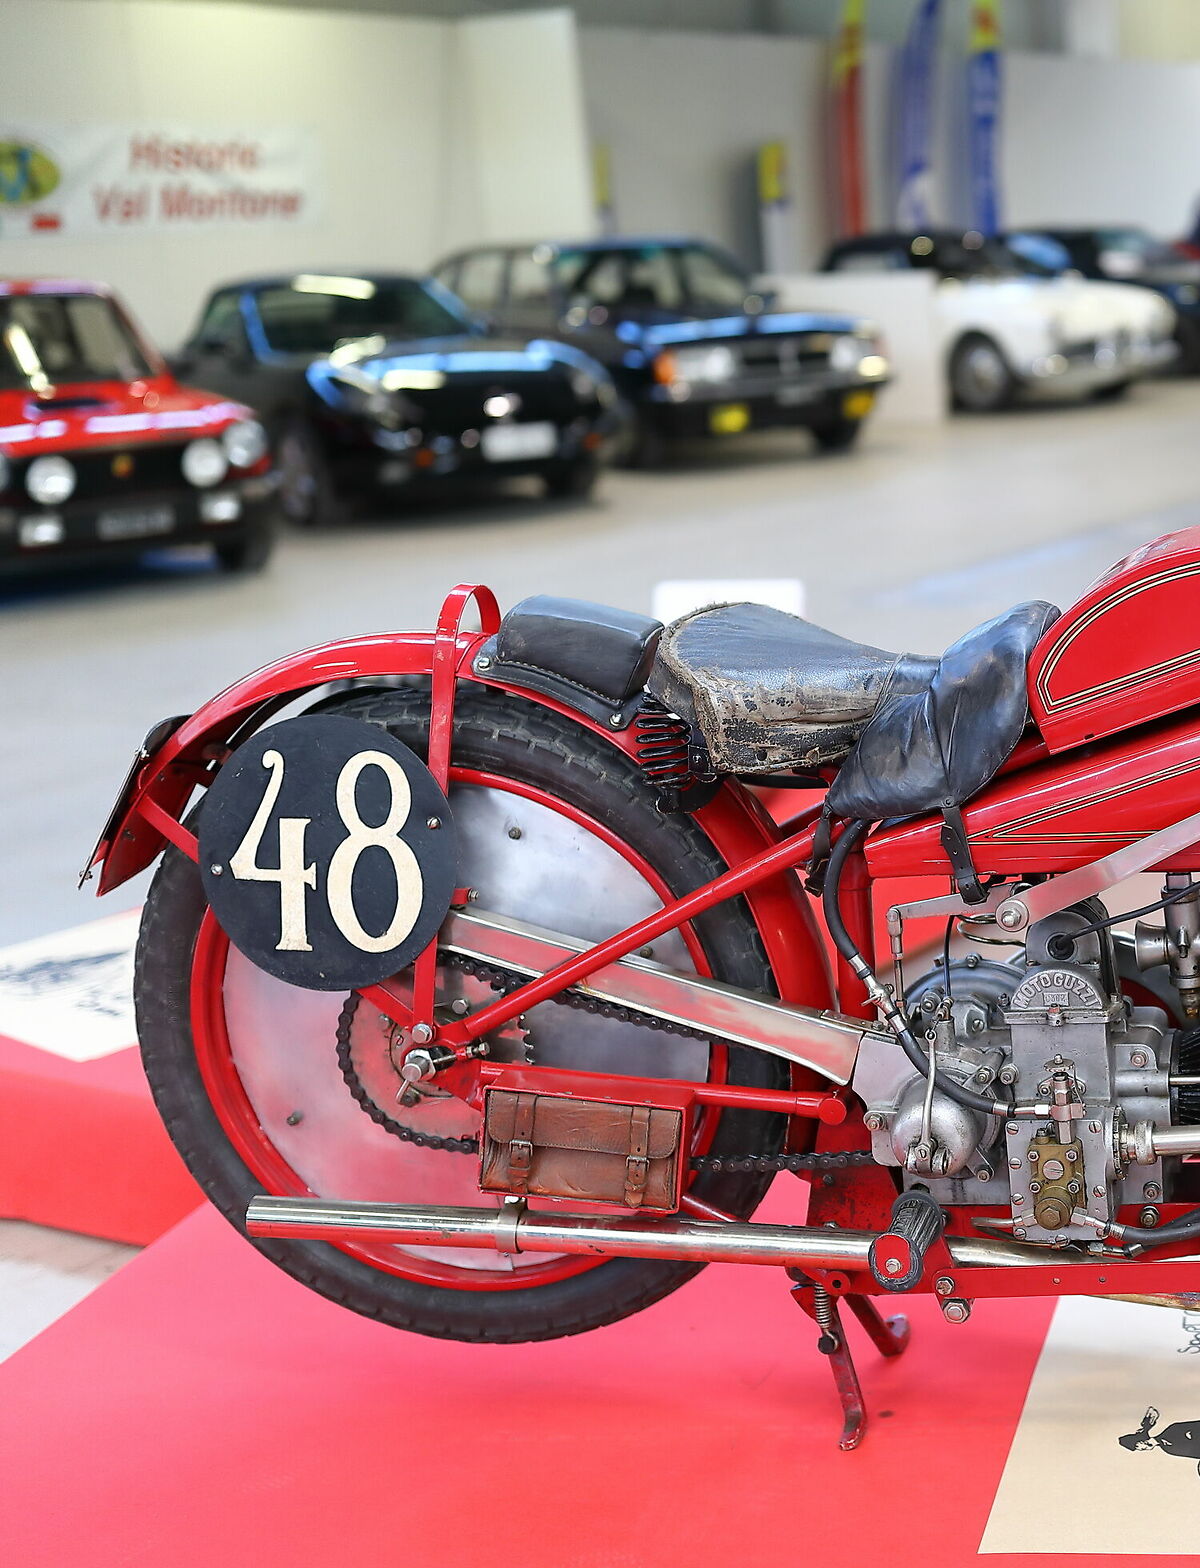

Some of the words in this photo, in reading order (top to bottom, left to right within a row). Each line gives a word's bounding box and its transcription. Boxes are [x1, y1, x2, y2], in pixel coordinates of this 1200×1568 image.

[228, 749, 424, 953] 48
[1013, 973, 1052, 1009] MOTO
[1053, 972, 1099, 1007] GUZZI
